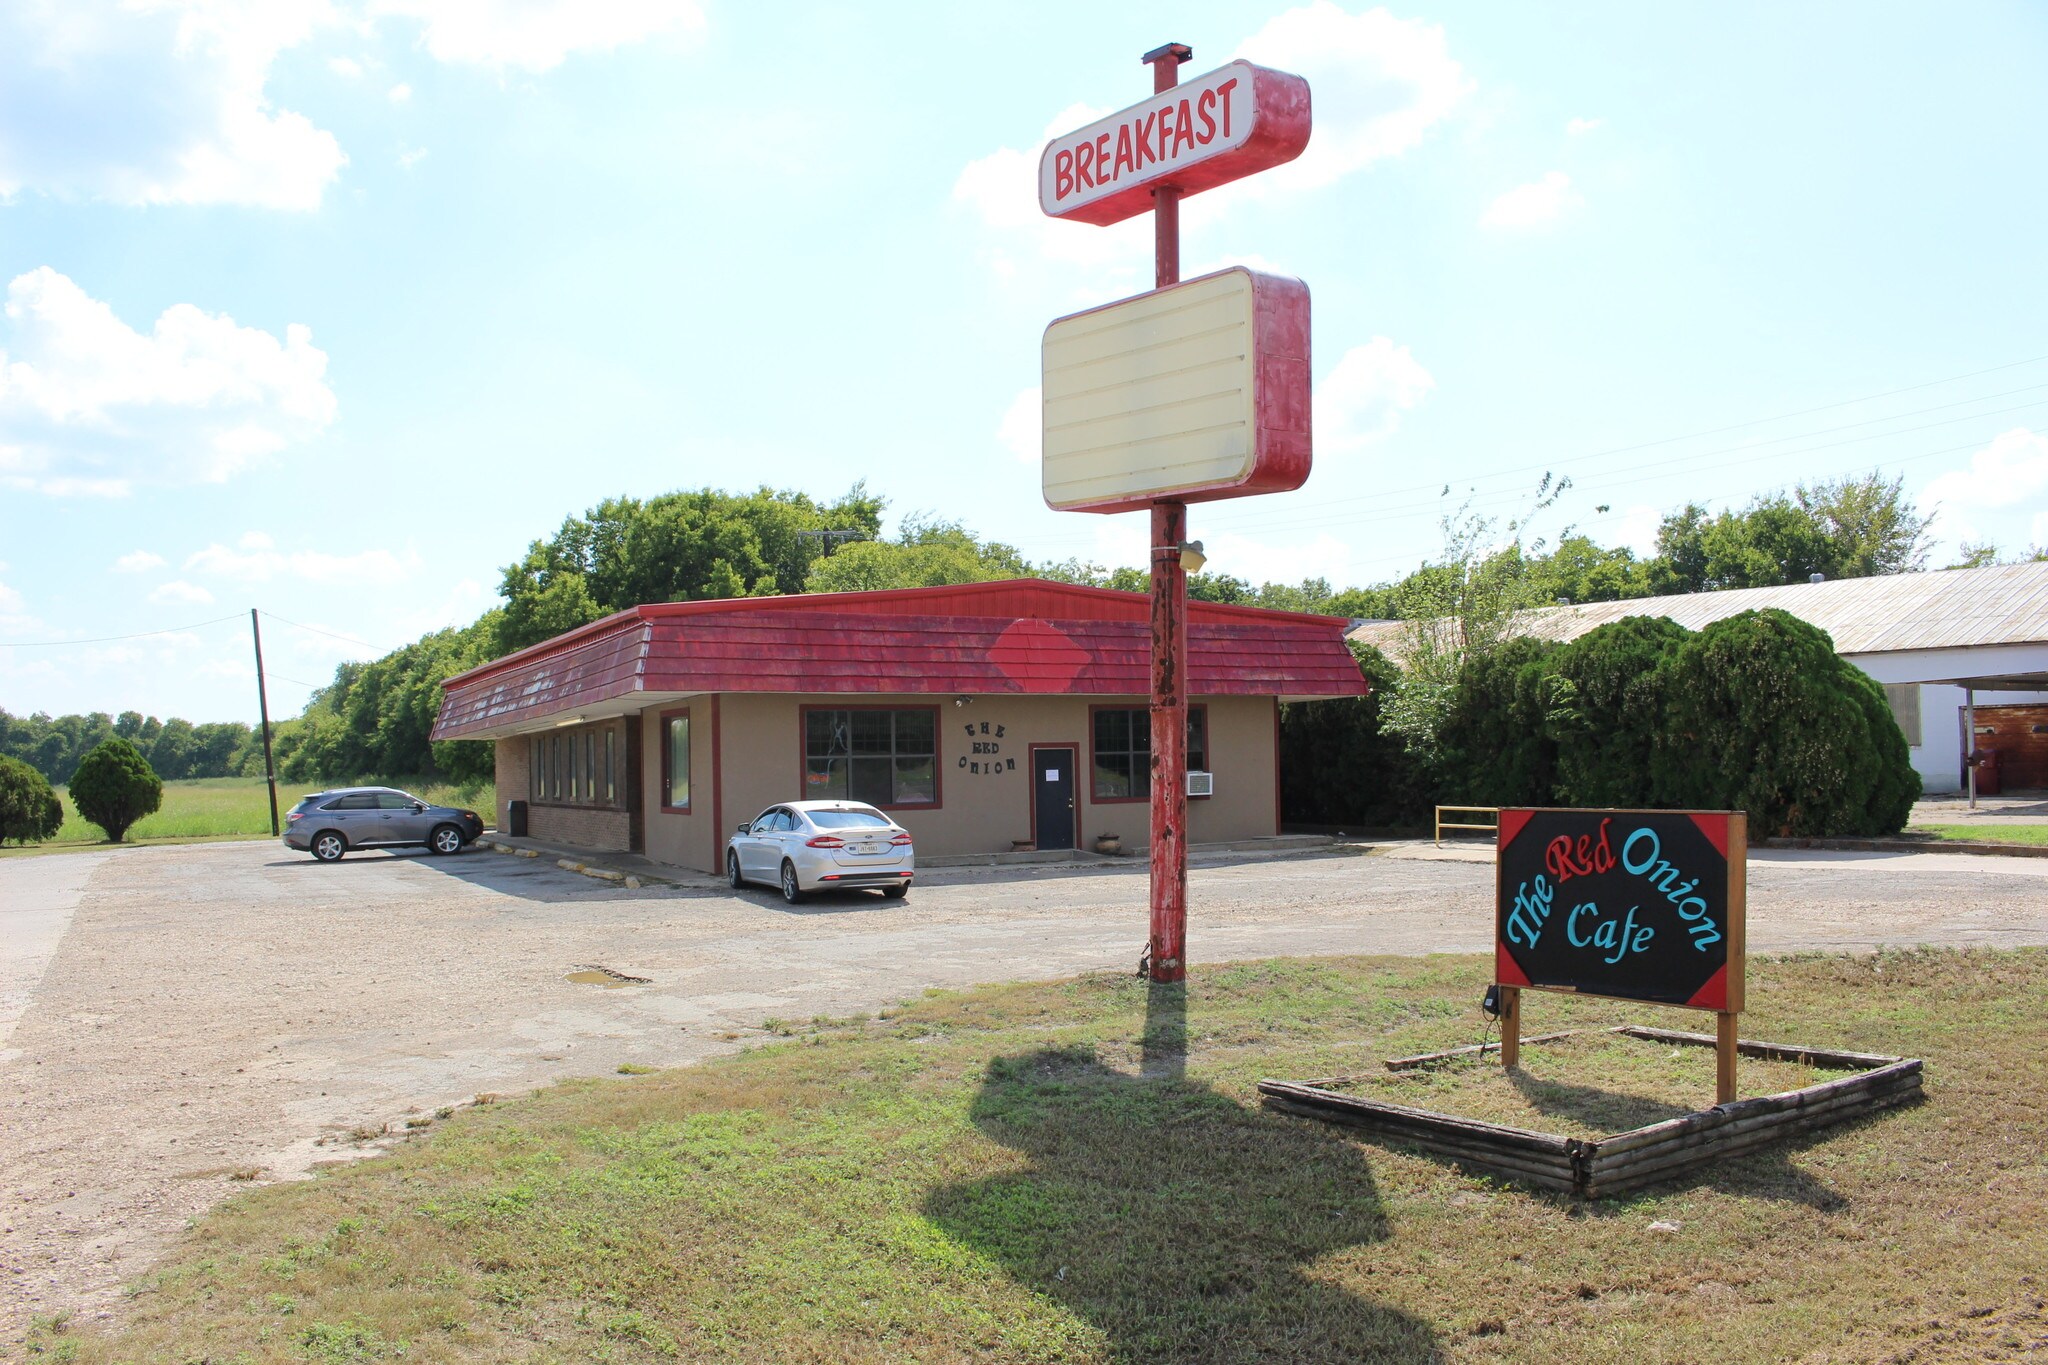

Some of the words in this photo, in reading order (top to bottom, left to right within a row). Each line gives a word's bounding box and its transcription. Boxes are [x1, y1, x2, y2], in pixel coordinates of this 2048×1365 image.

[1055, 77, 1237, 201] BREAKFAST
[964, 722, 1005, 738] THE
[972, 742, 999, 754] RED
[958, 756, 1015, 774] ONION
[1507, 874, 1553, 949] The
[1545, 817, 1616, 883] Red
[1622, 827, 1721, 952] Onion
[1567, 902, 1655, 964] Cafe
